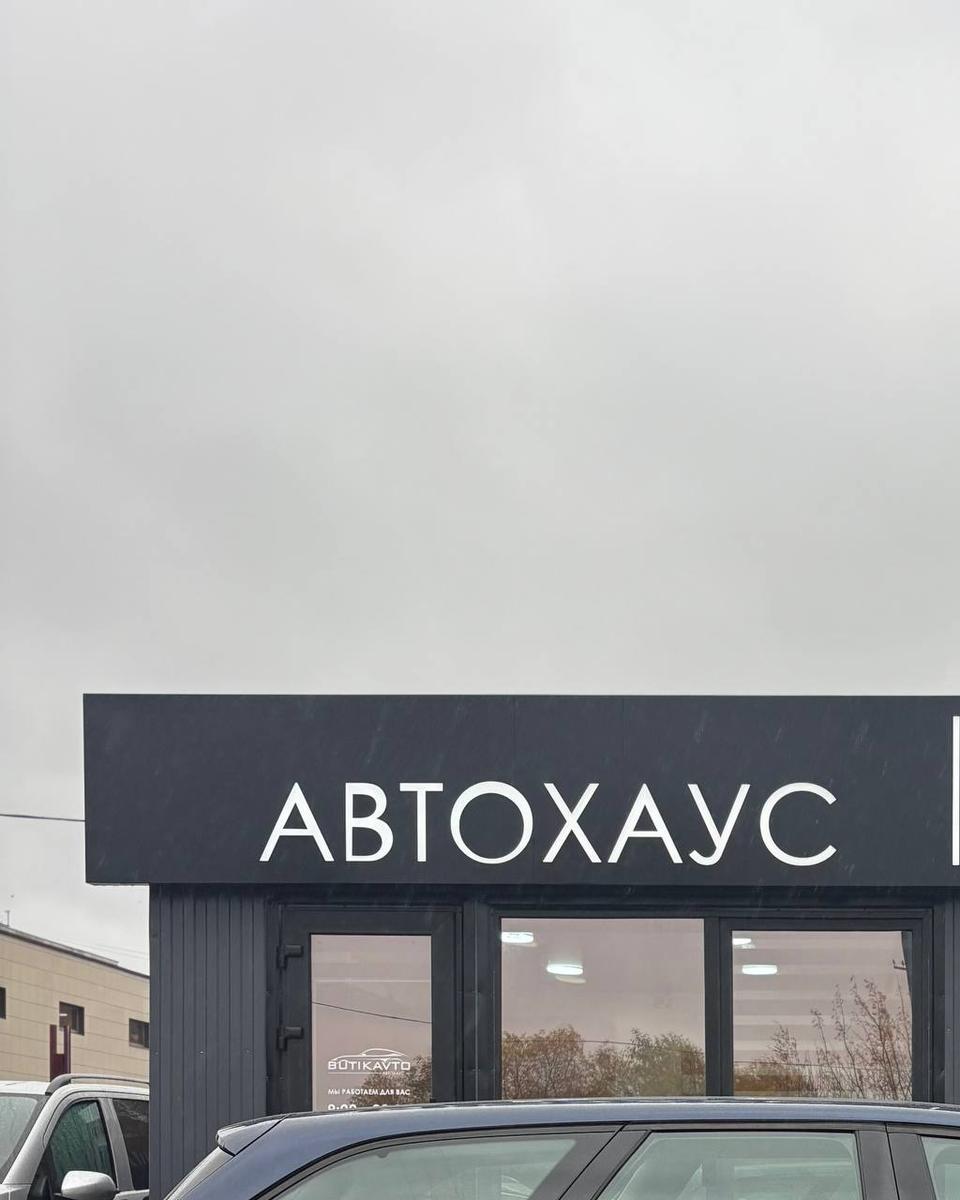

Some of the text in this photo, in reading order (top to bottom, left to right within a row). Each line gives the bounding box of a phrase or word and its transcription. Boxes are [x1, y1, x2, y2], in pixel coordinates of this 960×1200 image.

[259, 781, 837, 866] АВТОХАУС
[327, 1060, 411, 1071] BUTIKAVTO
[327, 1088, 411, 1097] МЫ РАБОТАЕМ ДЛЯ ВАС
